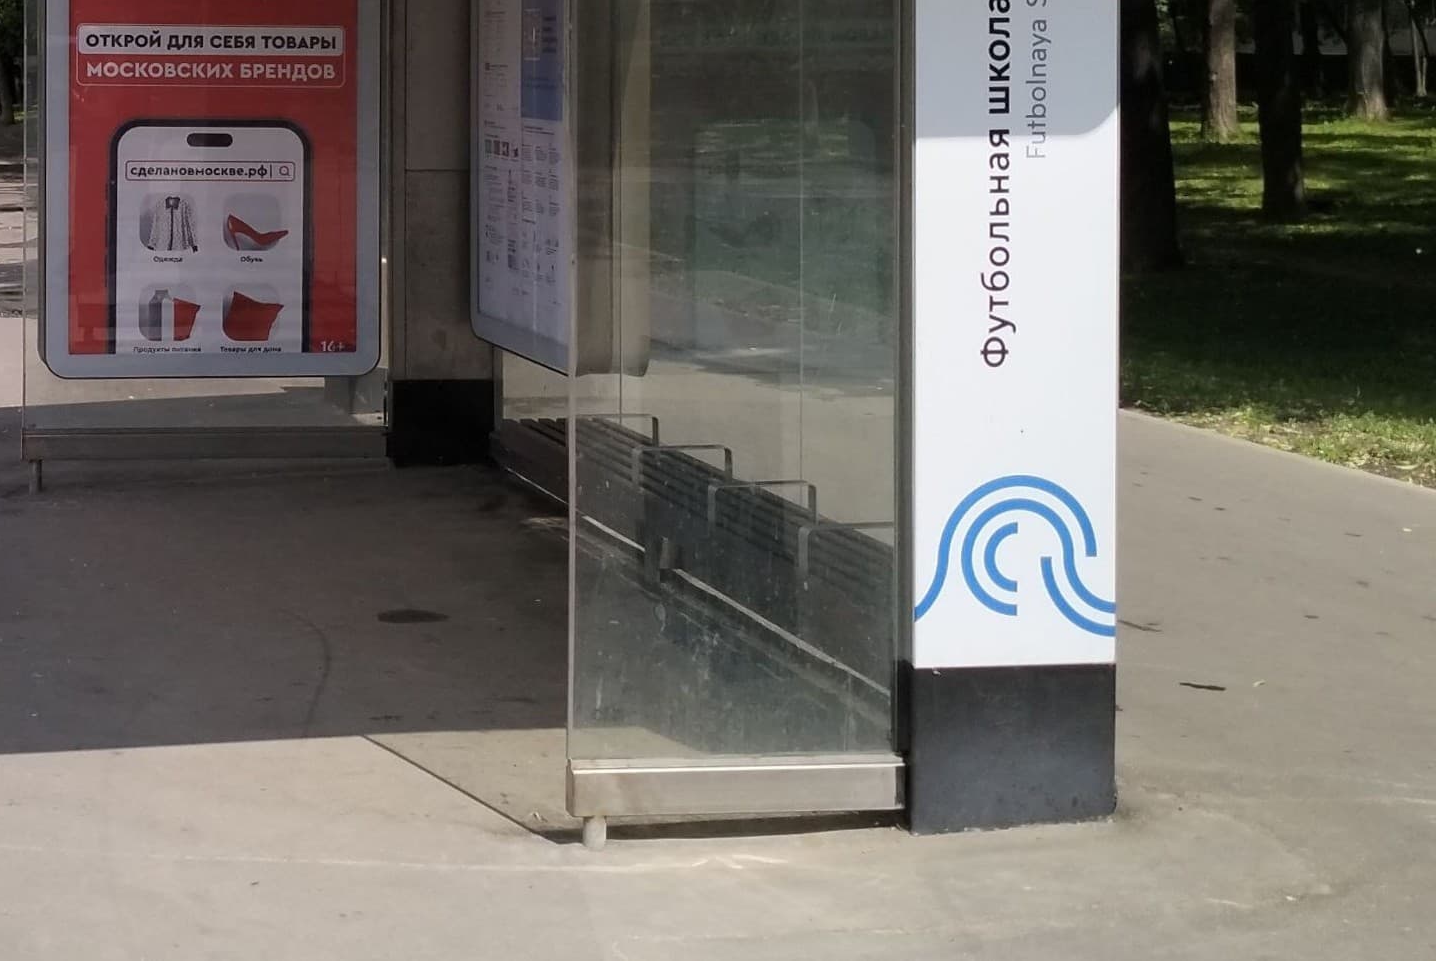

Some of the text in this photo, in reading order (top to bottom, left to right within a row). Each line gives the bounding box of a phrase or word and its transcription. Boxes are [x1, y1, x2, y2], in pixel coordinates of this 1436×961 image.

[85, 30, 337, 51] ОТКРОЙ ДЛЯ СЕБЯ ТОВАРЫ
[86, 61, 336, 81] МОСКОВСКИХ БРЕНДОВ
[1025, 18, 1052, 160] Futbolnaya
[980, 127, 1017, 369] Футбольная
